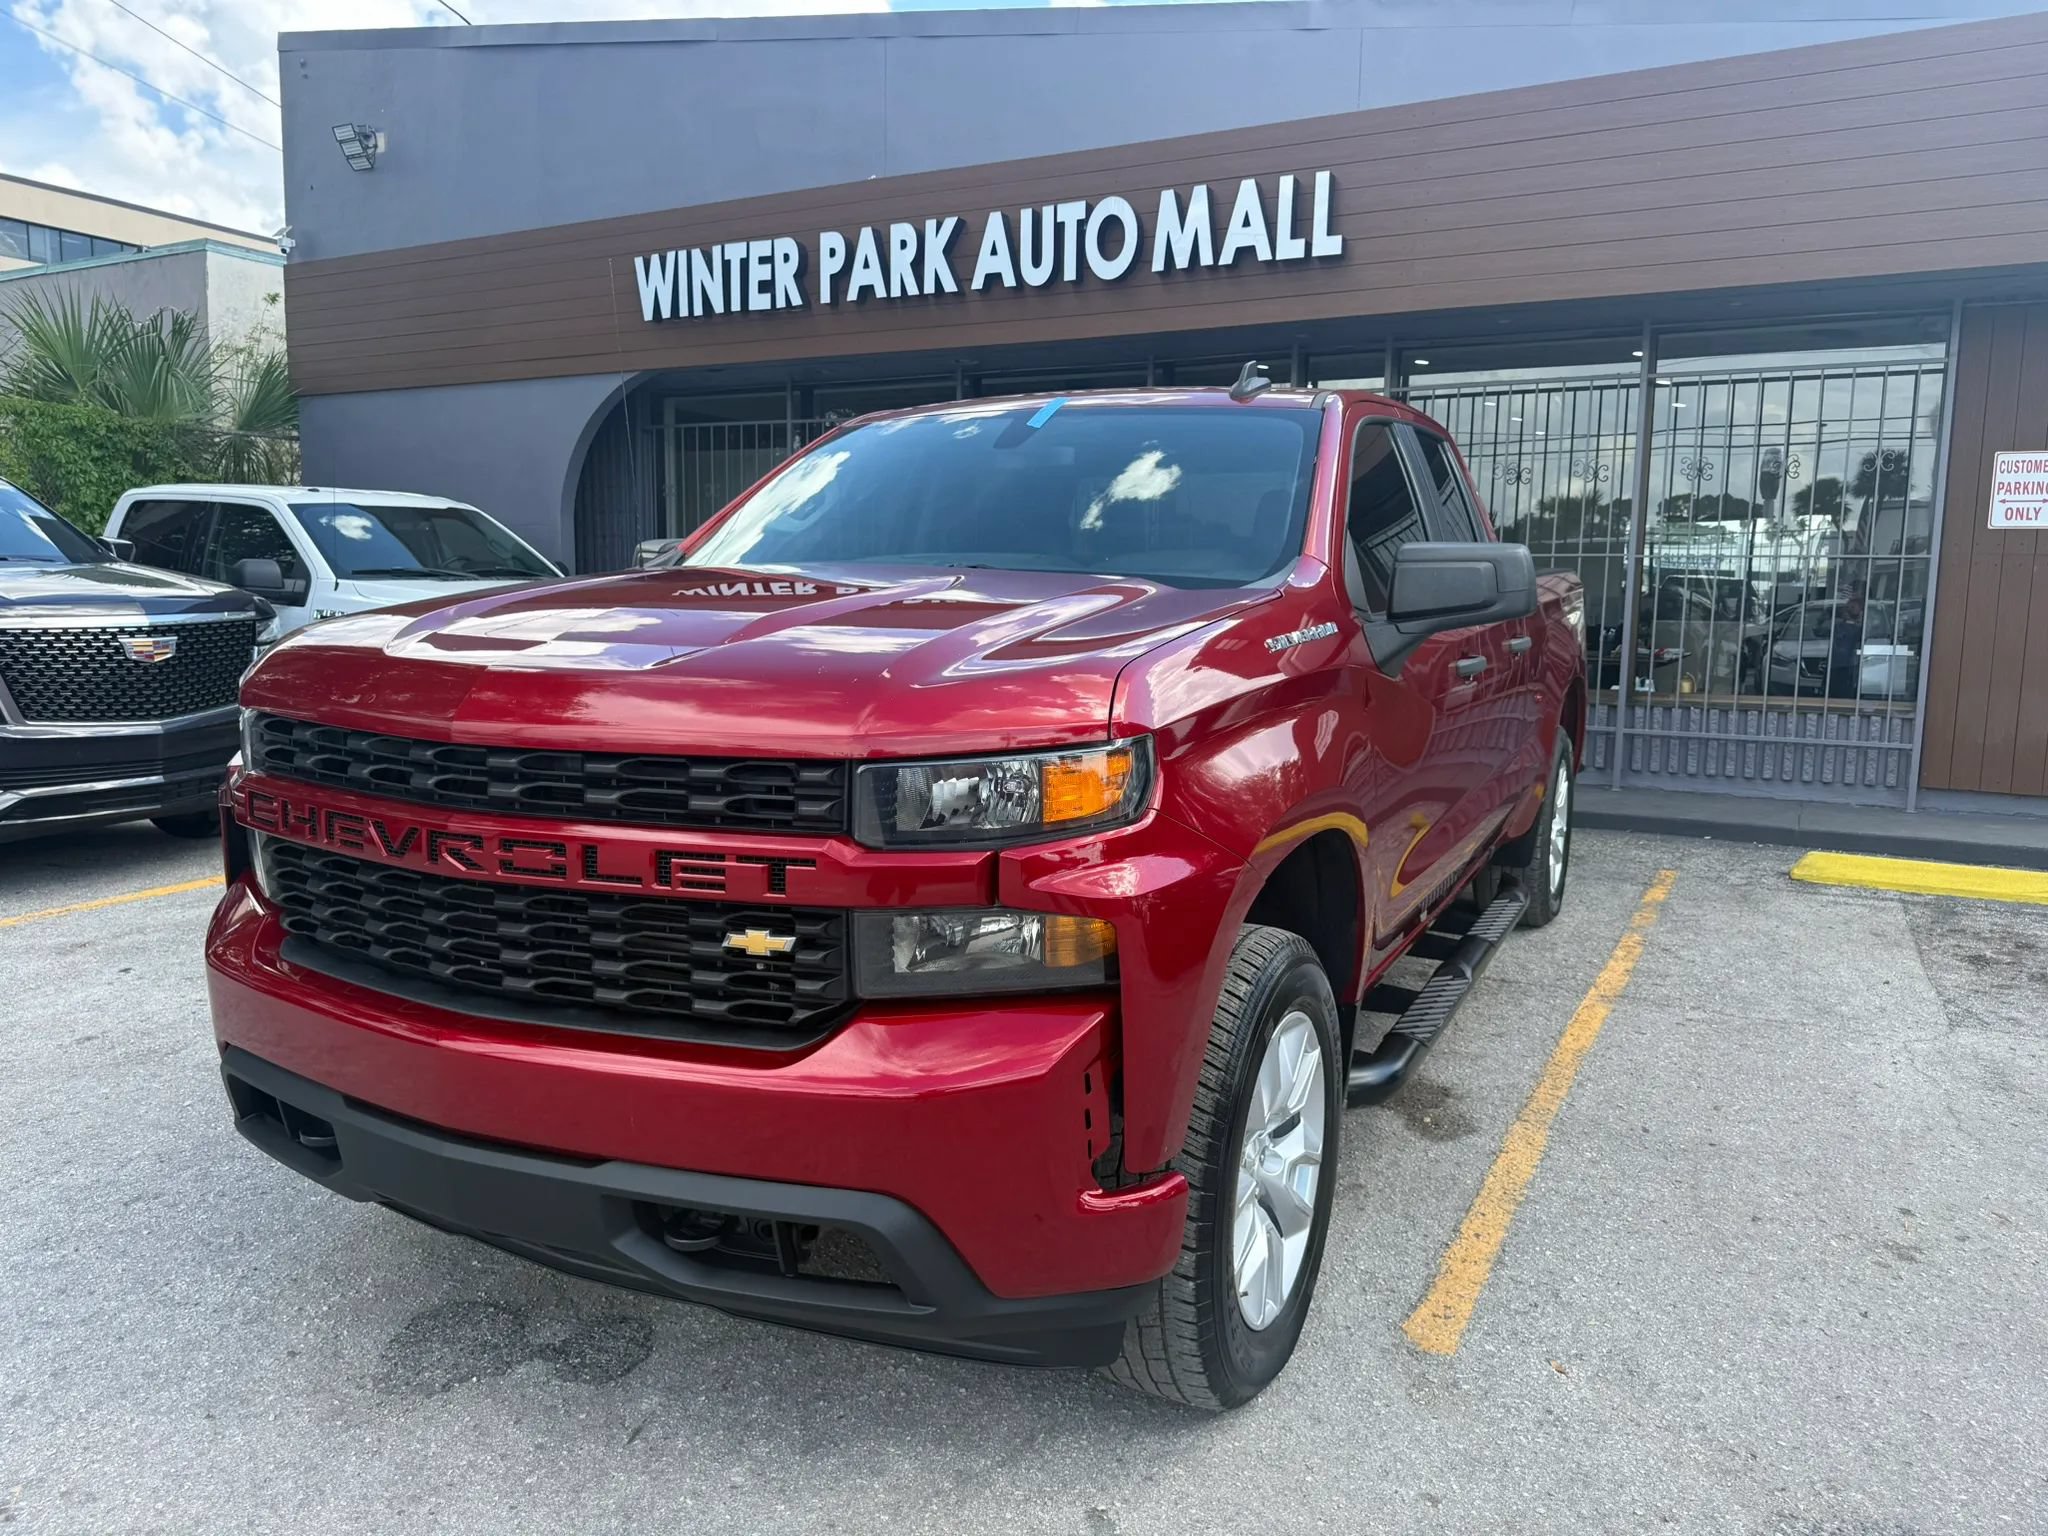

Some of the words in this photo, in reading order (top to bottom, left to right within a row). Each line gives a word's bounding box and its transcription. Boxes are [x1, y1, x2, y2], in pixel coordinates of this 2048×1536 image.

[634, 236, 803, 322] WINTER
[819, 217, 960, 305] PARK
[971, 196, 1138, 289] AUTO
[1151, 170, 1343, 273] MALL
[2005, 507, 2042, 521] ONLY
[246, 789, 817, 897] CHEVROLET
